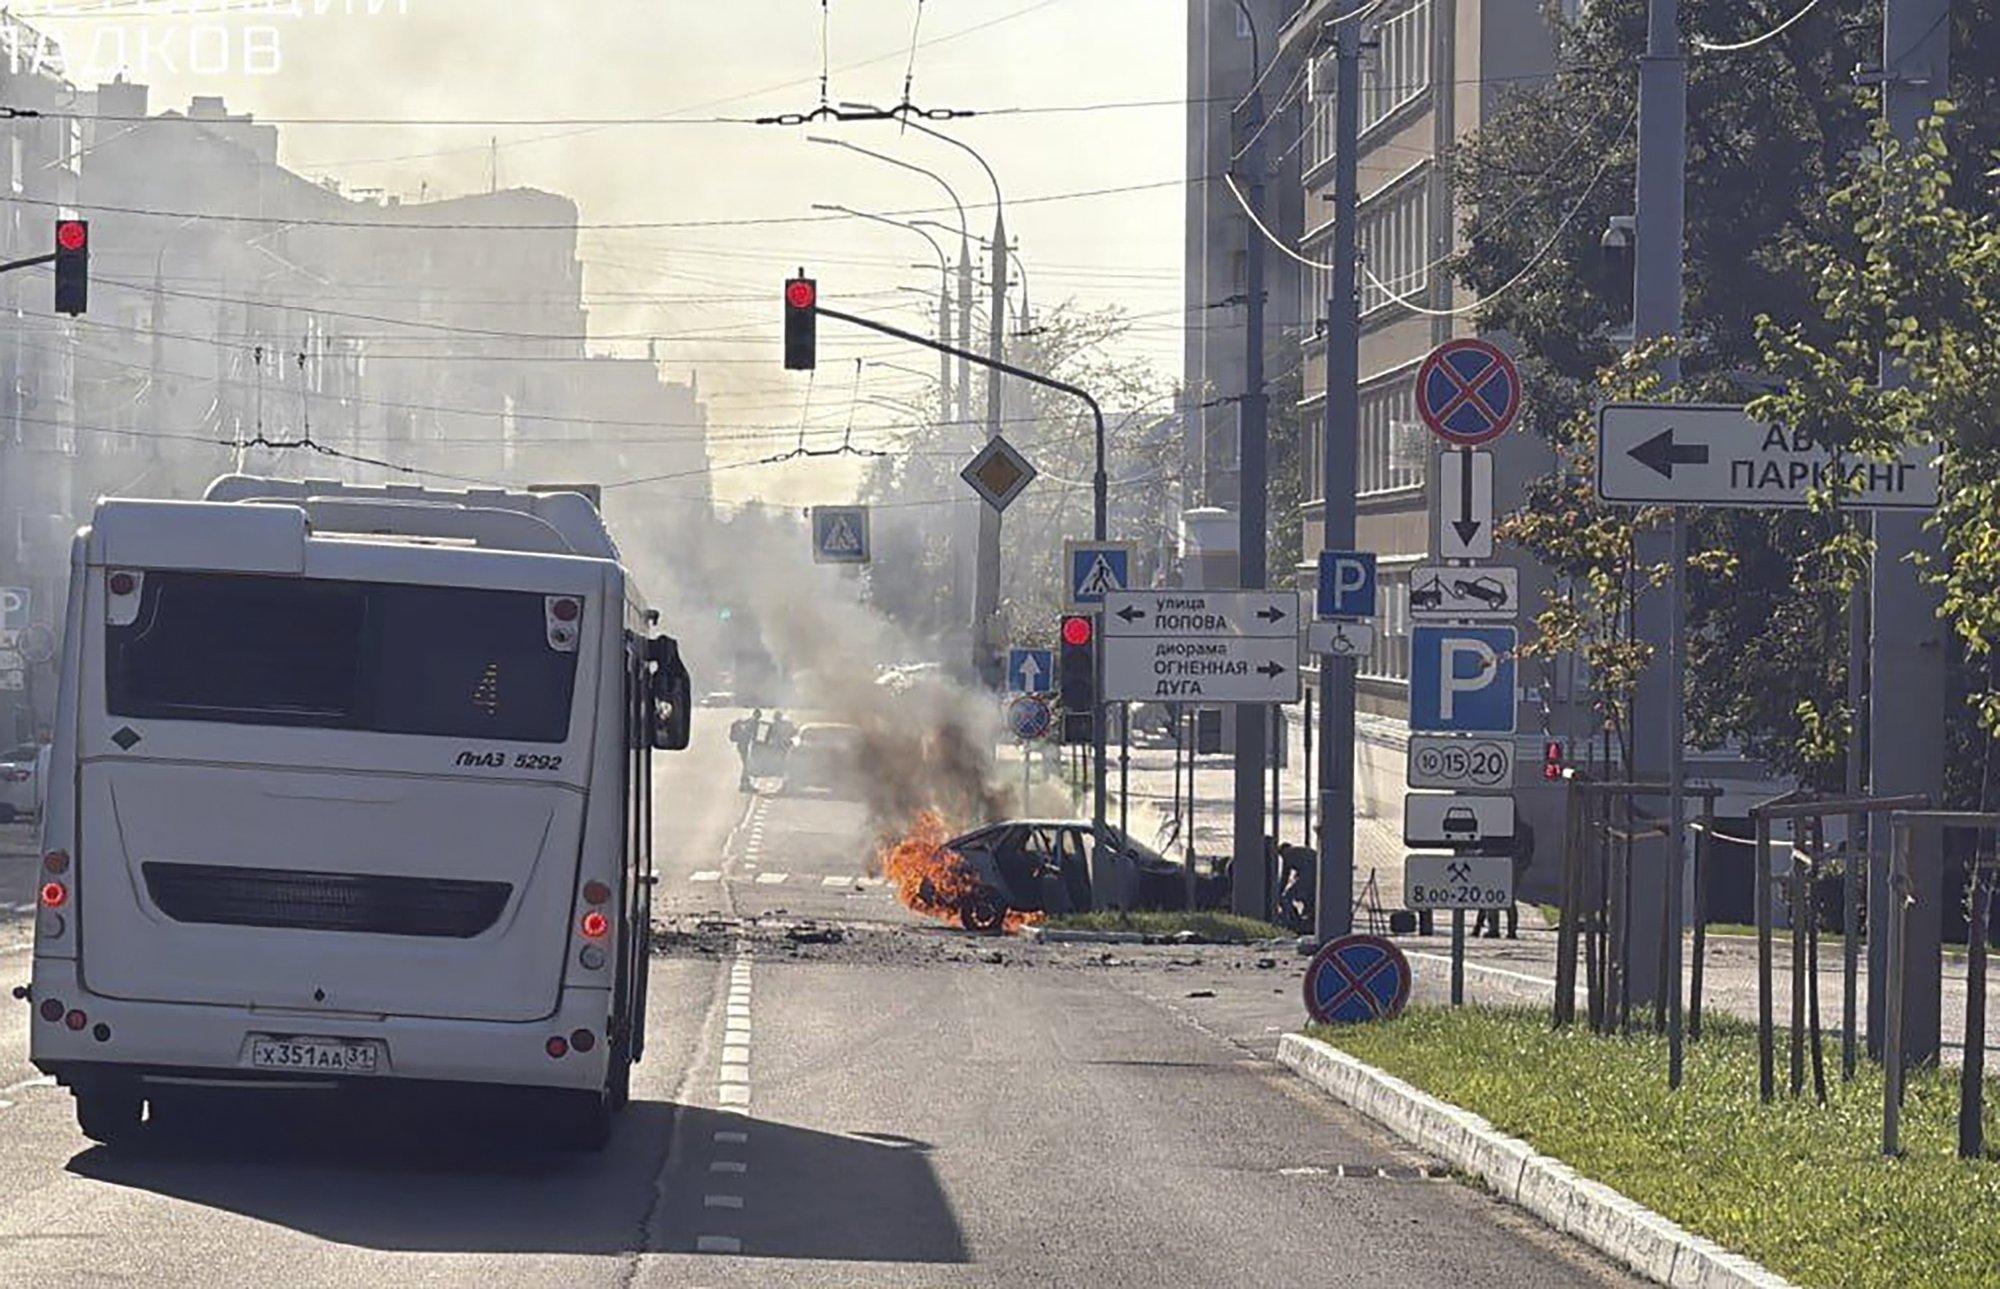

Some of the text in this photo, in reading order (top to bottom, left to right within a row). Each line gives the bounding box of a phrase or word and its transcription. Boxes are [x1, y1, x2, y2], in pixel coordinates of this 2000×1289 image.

[1335, 559, 1367, 609] P
[1156, 598, 1205, 612] улица
[1155, 615, 1227, 629] ПОПОВА
[1156, 644, 1227, 657] диорама
[1154, 661, 1248, 674] ОГНЕННАЯ
[1440, 638, 1497, 720] P
[1155, 680, 1202, 695] ДУГА
[514, 755, 562, 770] 5292
[1422, 752, 1503, 775] 10 15 20
[348, 1047, 368, 1063] 31
